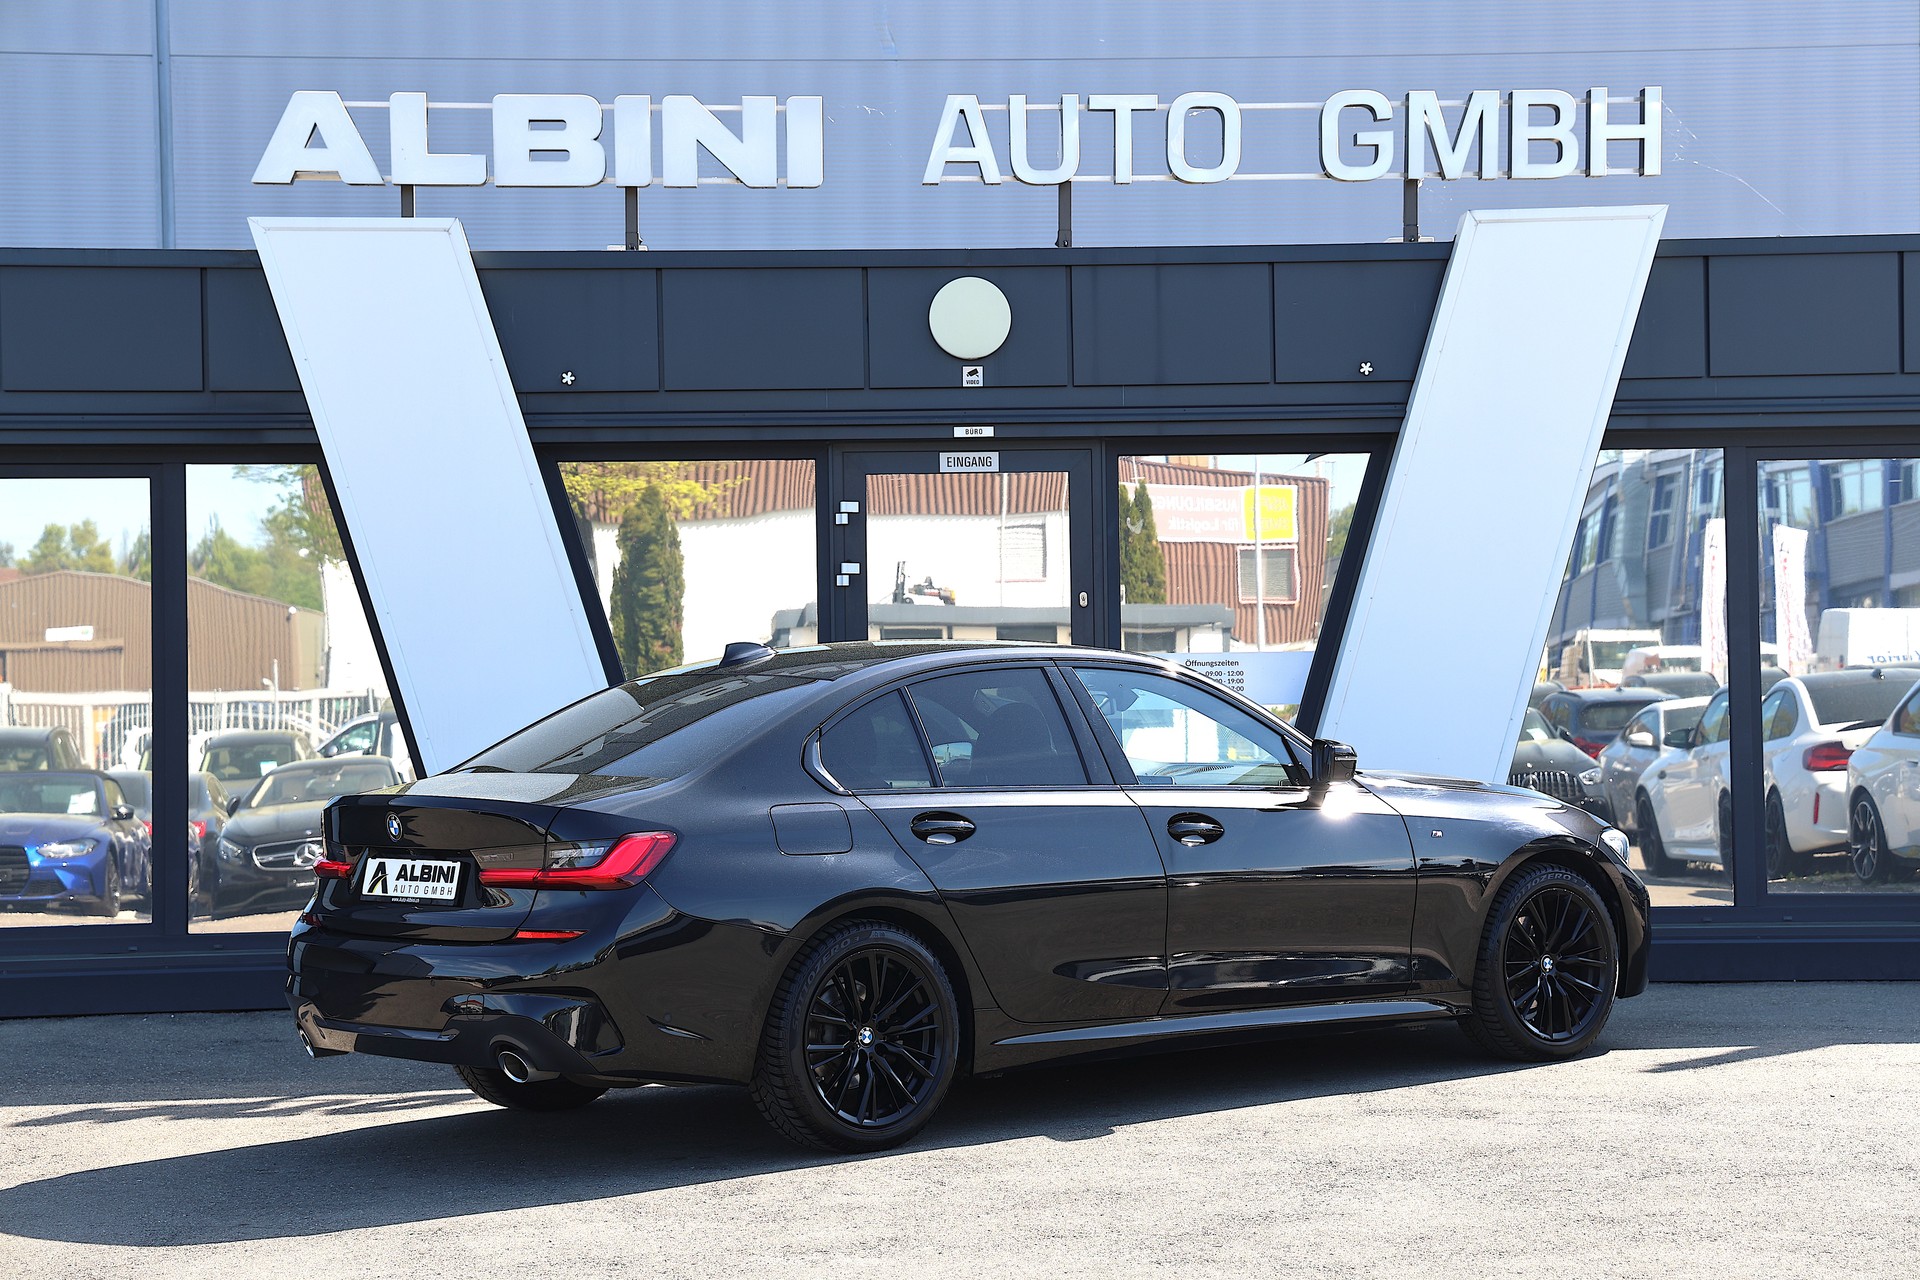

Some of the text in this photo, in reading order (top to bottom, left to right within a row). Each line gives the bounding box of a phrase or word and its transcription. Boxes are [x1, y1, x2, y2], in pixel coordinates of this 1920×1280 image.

[250, 86, 1664, 188] ALBINI AUTO GMBH
[946, 456, 992, 468] EINGANG
[1185, 659, 1239, 668] Öffnungszeiten
[395, 863, 456, 883] ALBINI
[393, 884, 453, 896] AUTO GMBH
